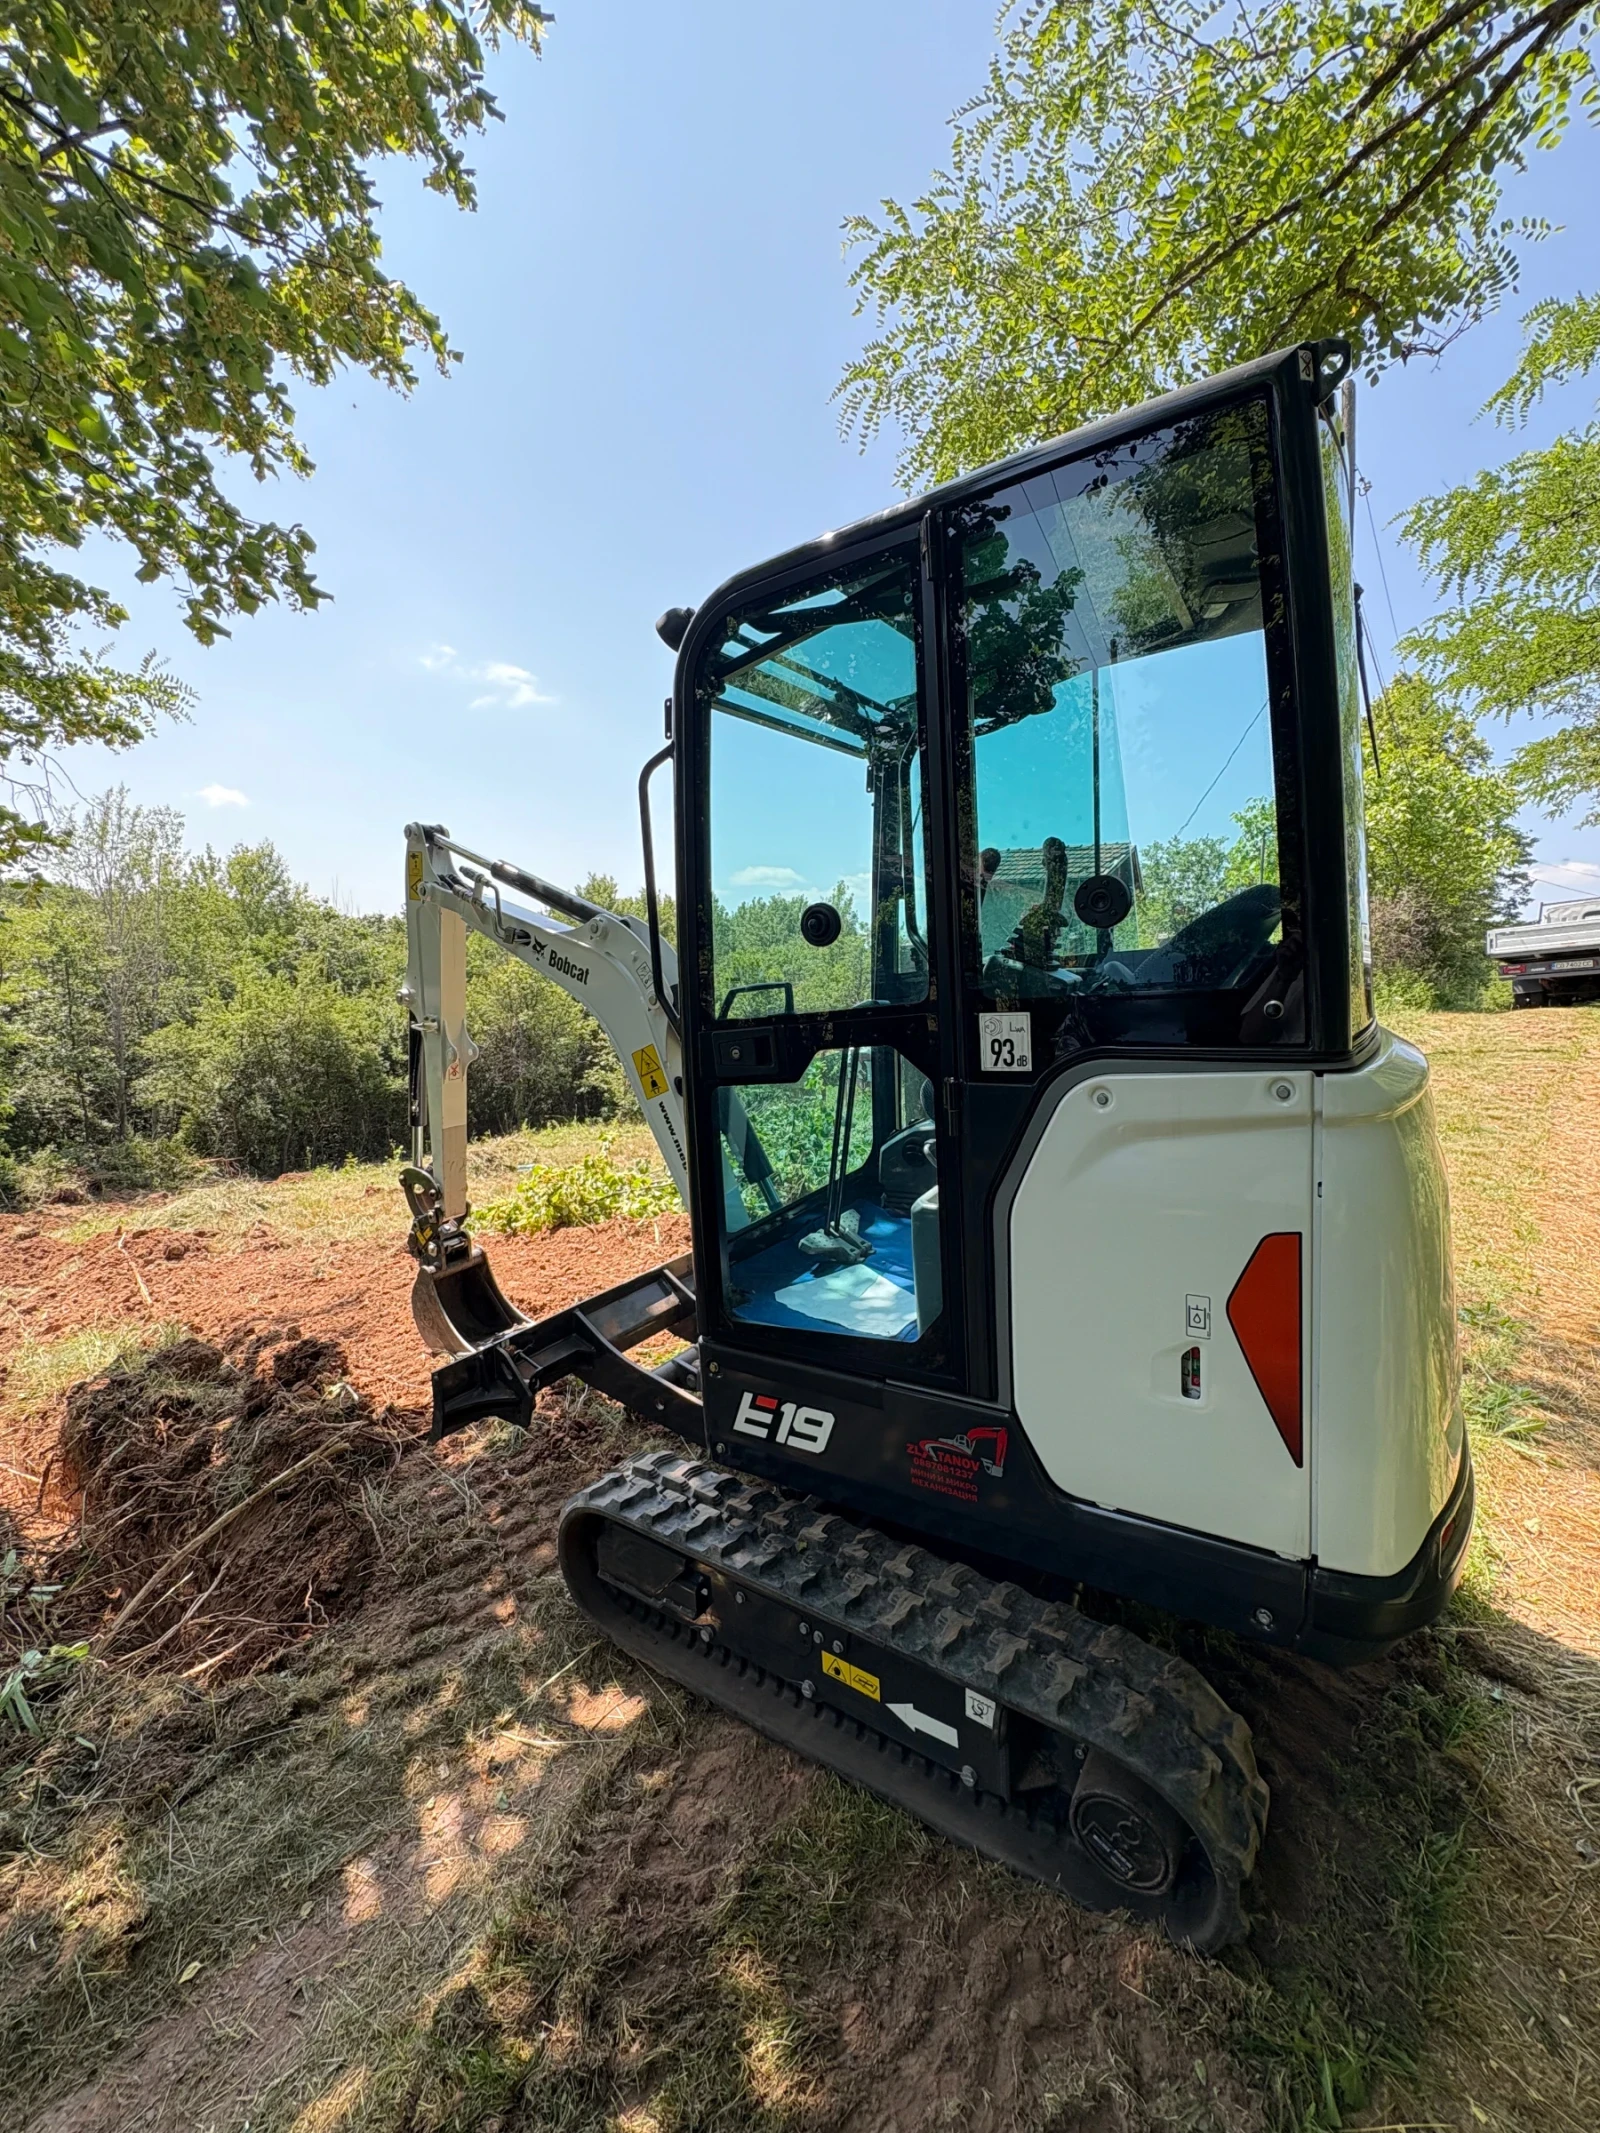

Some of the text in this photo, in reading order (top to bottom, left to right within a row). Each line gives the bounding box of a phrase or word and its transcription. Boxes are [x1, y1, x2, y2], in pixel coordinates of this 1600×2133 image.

[548, 949, 590, 985] Bobcat
[990, 1038, 1028, 1067] 93 dB
[733, 1391, 836, 1454] E19
[910, 1467, 978, 1493] МИНИ И МИКРО
[913, 1457, 974, 1479] 0887081237
[911, 1477, 978, 1502] МЕХАНИЗАЦИЯ
